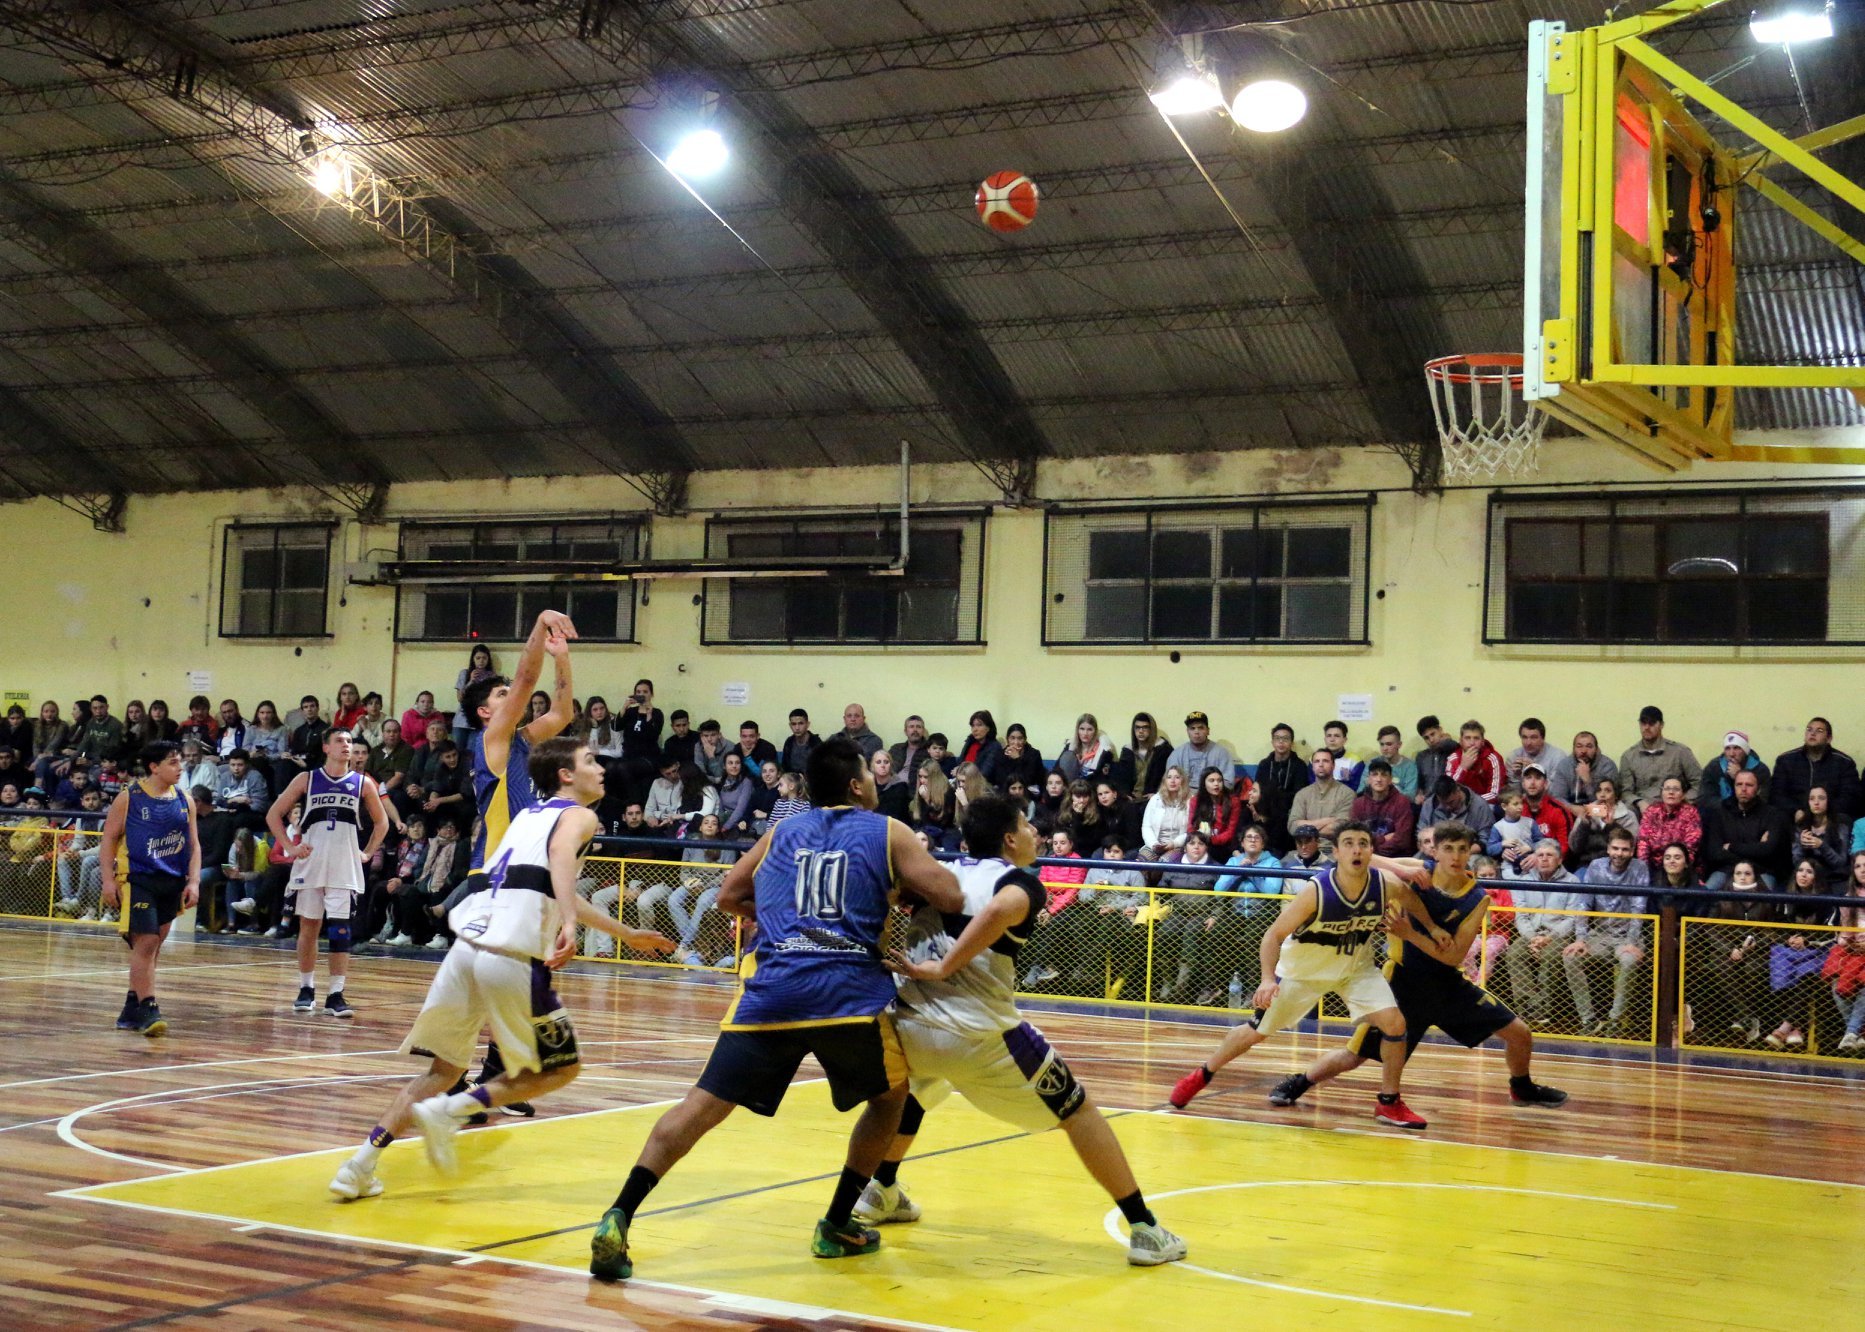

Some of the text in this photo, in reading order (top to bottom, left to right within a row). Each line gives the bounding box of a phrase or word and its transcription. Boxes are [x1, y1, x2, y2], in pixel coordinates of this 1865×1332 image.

[311, 795, 336, 807] PICO
[326, 808, 338, 831] 5
[488, 847, 514, 899] 4
[794, 847, 848, 921] 10
[1336, 932, 1358, 956] 10
